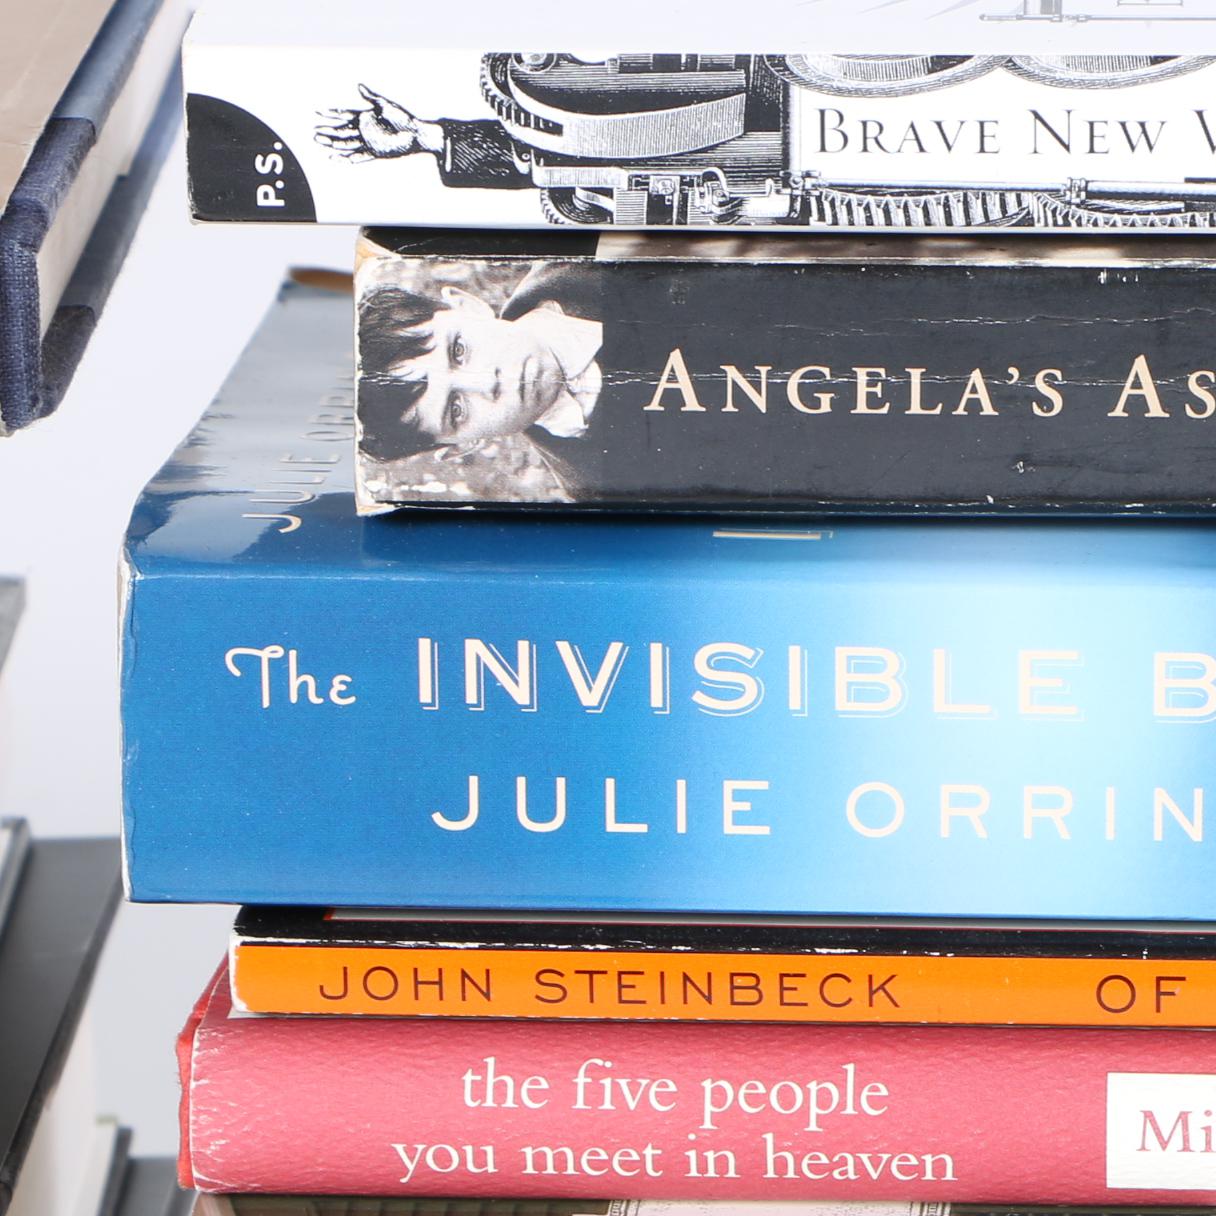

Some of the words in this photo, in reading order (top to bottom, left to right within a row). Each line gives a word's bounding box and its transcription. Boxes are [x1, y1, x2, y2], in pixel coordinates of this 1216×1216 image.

[818, 108, 999, 154] BRAVE
[1029, 109, 1166, 155] NEW
[255, 140, 284, 207] P.S.
[643, 348, 1068, 417] ANGELA'S
[224, 644, 356, 709] The
[416, 636, 1083, 723] INVISIBLE
[431, 775, 774, 837] JULIE
[319, 965, 491, 1002] JOHN
[535, 968, 900, 1008] STEINBECK
[1095, 974, 1187, 1014] OF
[461, 1056, 550, 1109] the
[571, 1058, 678, 1112] five
[700, 1062, 889, 1131] people
[392, 1142, 496, 1183] you
[518, 1143, 664, 1177] meet
[684, 1132, 739, 1178] in
[761, 1129, 958, 1181] heaven
